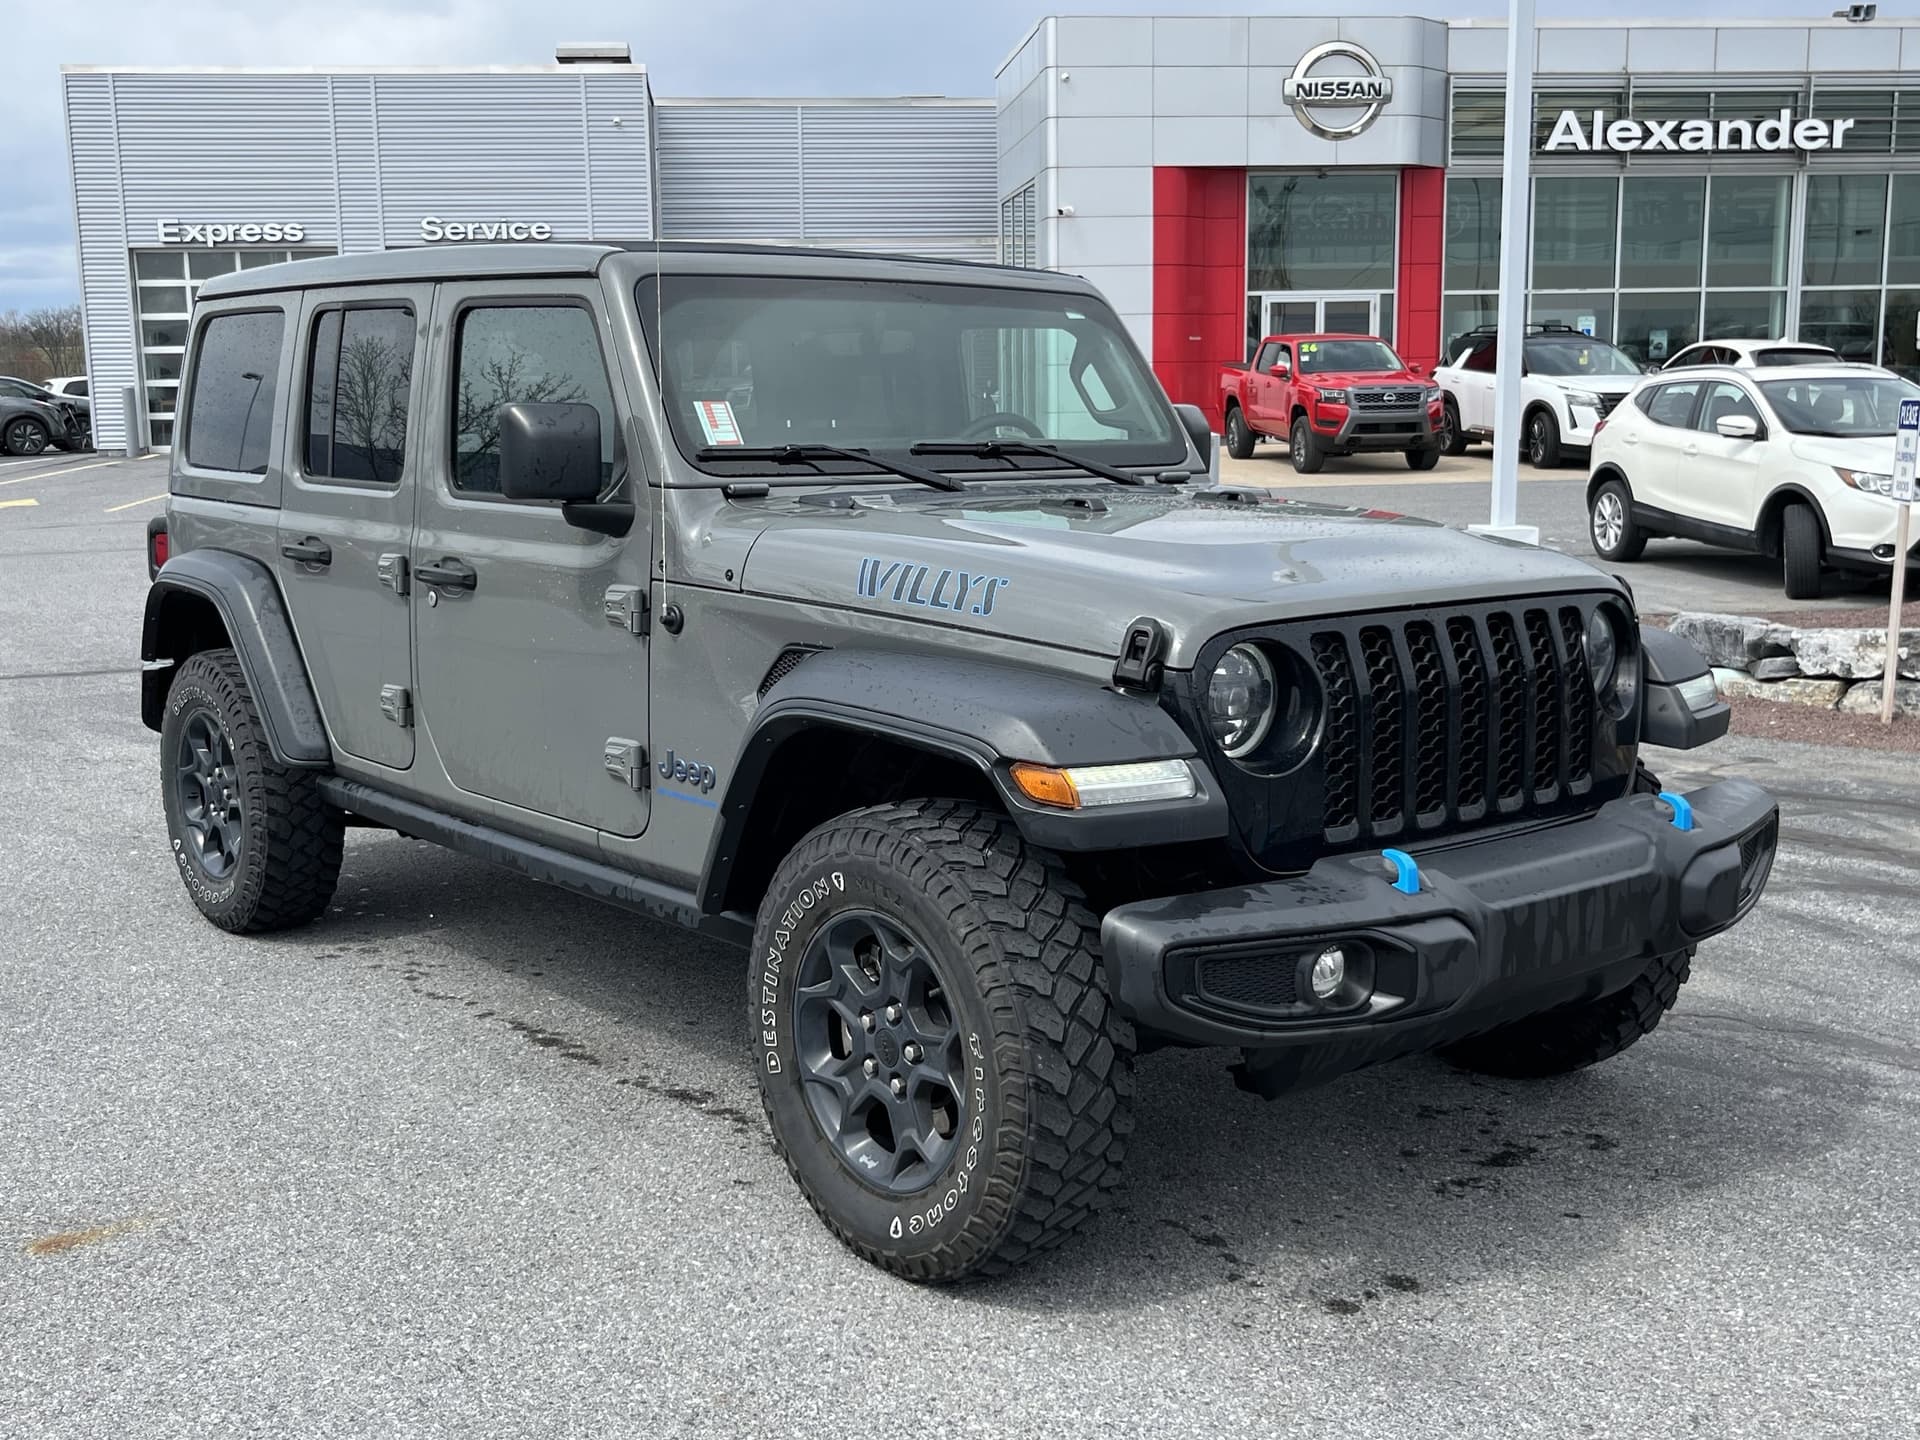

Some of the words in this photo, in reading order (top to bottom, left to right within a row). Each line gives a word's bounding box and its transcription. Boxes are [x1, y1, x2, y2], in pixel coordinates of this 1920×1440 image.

[1294, 80, 1385, 101] NISSAN
[1544, 109, 1855, 152] Alexander
[156, 217, 306, 248] Express
[420, 215, 554, 242] Service
[1301, 344, 1318, 352] 26
[1900, 405, 1919, 425] PLEASE
[857, 557, 1010, 618] WILLYS
[657, 748, 717, 795] Jeep
[762, 877, 831, 1075] DESTINATION
[908, 1032, 986, 1235] Firestone
